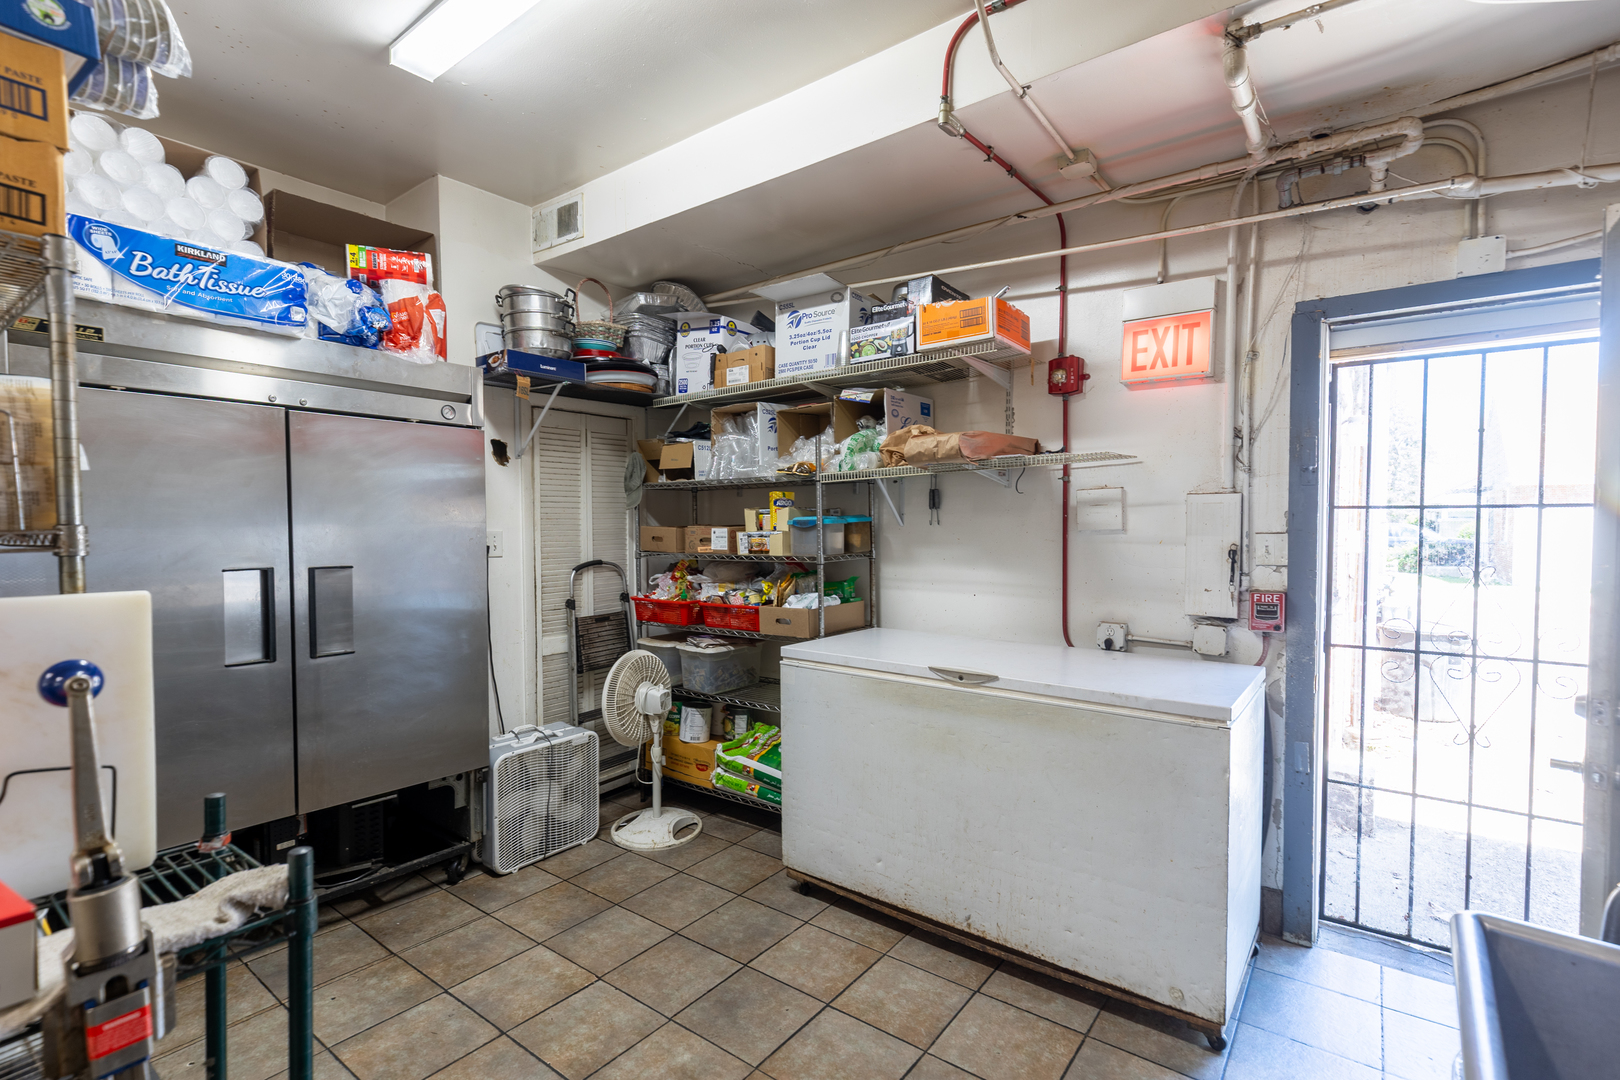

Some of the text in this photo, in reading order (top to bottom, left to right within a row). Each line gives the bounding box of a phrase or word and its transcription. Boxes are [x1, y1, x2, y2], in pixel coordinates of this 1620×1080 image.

[4, 65, 44, 86] PASTE
[176, 244, 226, 263] KIRKLAND
[129, 250, 198, 285] Bath
[197, 264, 266, 299] Tissue
[198, 292, 233, 303] Absorbent
[801, 312, 812, 320] Pro
[813, 308, 835, 318] Source
[790, 338, 809, 346] Portion
[1130, 321, 1201, 372] EXIT
[778, 361, 788, 369] CASE
[789, 359, 807, 367] QUANTITY
[1253, 593, 1280, 603] FIRE
